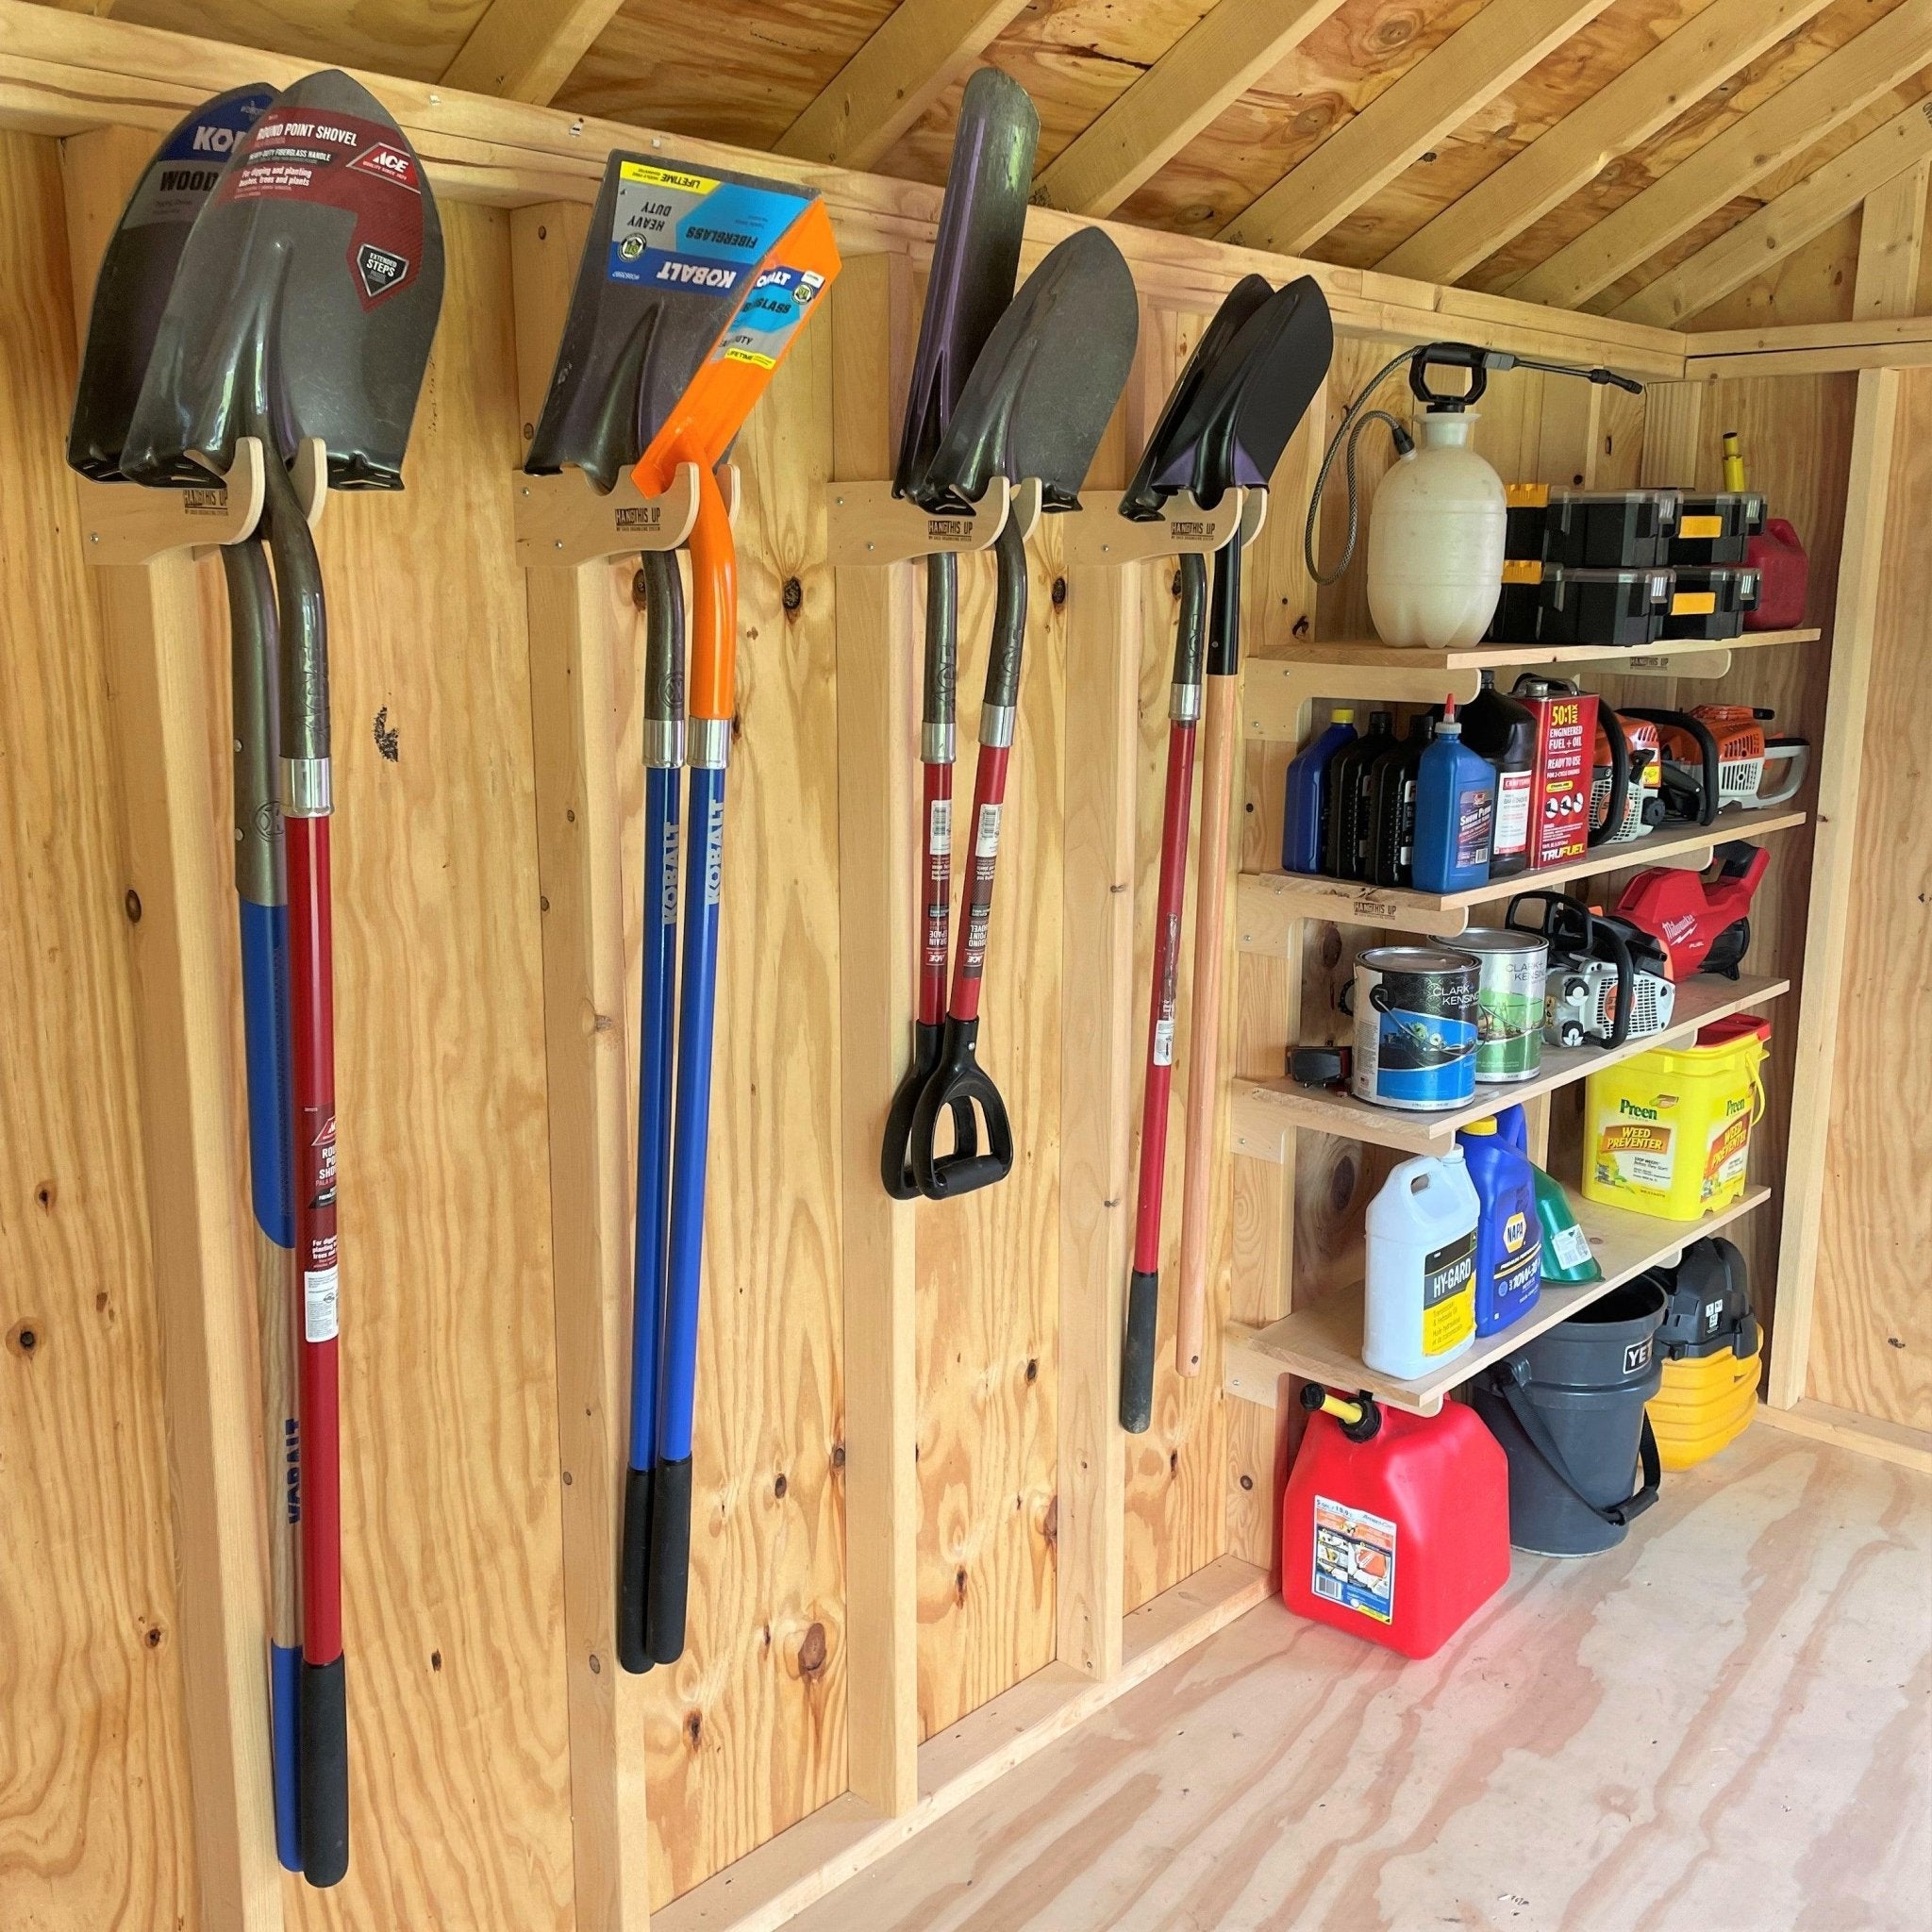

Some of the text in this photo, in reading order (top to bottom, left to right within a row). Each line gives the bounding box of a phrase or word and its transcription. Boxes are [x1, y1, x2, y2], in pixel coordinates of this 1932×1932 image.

[256, 123, 358, 147] ROUND POINT SHOVEL
[308, 150, 332, 161] HANDLE
[373, 151, 409, 174] ACE
[272, 166, 284, 175] and
[285, 167, 312, 179] planting
[275, 175, 288, 184] and
[289, 176, 310, 186] plants
[159, 171, 220, 192] WOOD
[660, 173, 701, 190] LIFETIME
[641, 201, 672, 217] DUTY
[627, 215, 666, 232] HEAVY
[686, 225, 758, 249] FIBERGLASS
[366, 258, 395, 277] STEPS
[370, 252, 397, 268] EXTENDED
[656, 260, 737, 289] KOBALT
[651, 507, 660, 523] UP
[964, 521, 973, 535] UP
[1207, 523, 1215, 535] UP
[1551, 705, 1572, 726] 50:1
[1550, 725, 1583, 739] ENGINEERED
[1548, 736, 1582, 750] FUEL + OIL
[1547, 756, 1581, 770] READY TO USE
[706, 799, 724, 905] KOBALT
[1541, 842, 1586, 862] TRUFUEL
[662, 821, 679, 924] KOBALT
[1388, 905, 1397, 915] UP
[1662, 914, 1696, 942] Milwaukee
[1442, 991, 1480, 1006] KENSING
[1620, 1098, 1657, 1121] Preen
[1726, 1098, 1745, 1117] Preen
[1623, 1126, 1651, 1139] WEED
[1607, 1137, 1663, 1150] PREVENTER
[1507, 1222, 1524, 1242] NAPA
[1434, 1257, 1472, 1298] HY-GARD
